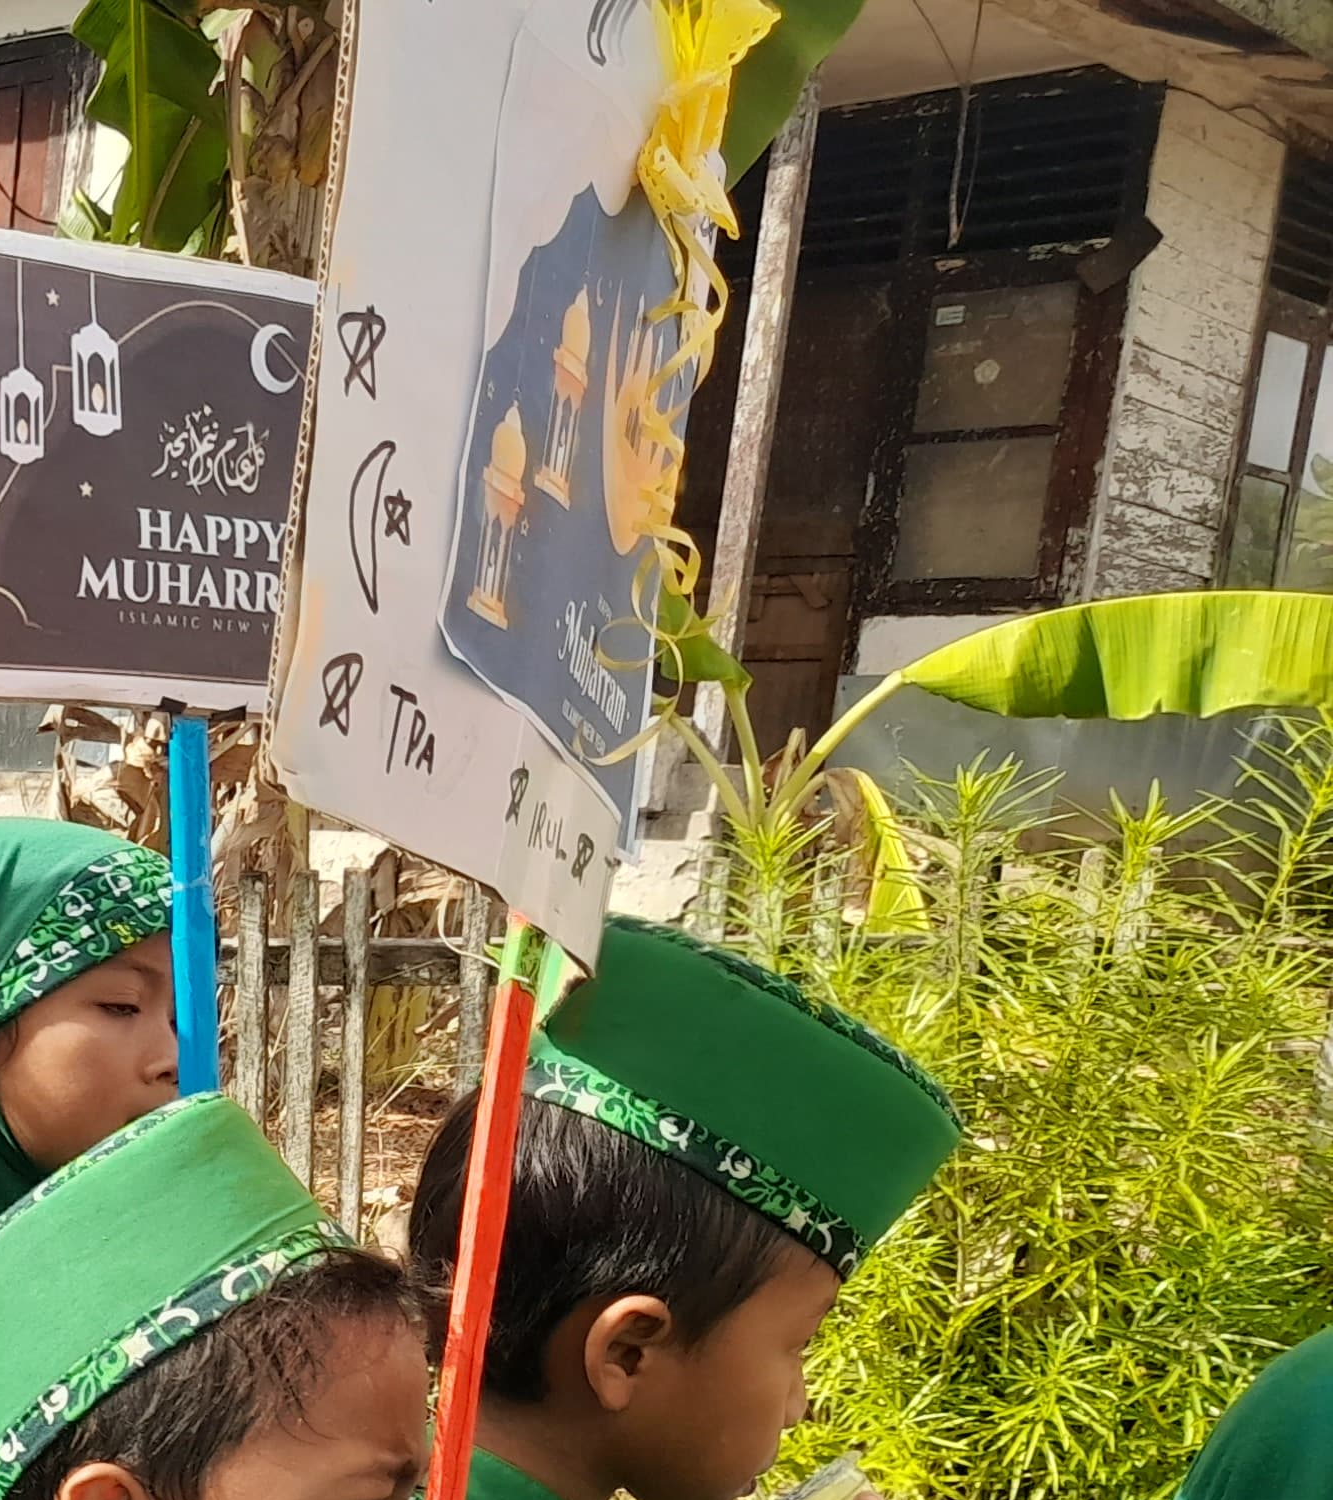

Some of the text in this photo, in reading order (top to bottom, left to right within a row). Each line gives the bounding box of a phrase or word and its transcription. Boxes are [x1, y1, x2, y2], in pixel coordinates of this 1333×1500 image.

[136, 507, 287, 563] HAPPY
[119, 610, 200, 629] ISLAMIC
[212, 616, 251, 634] NEW
[557, 600, 627, 735] Muharram
[385, 683, 435, 776] TPA
